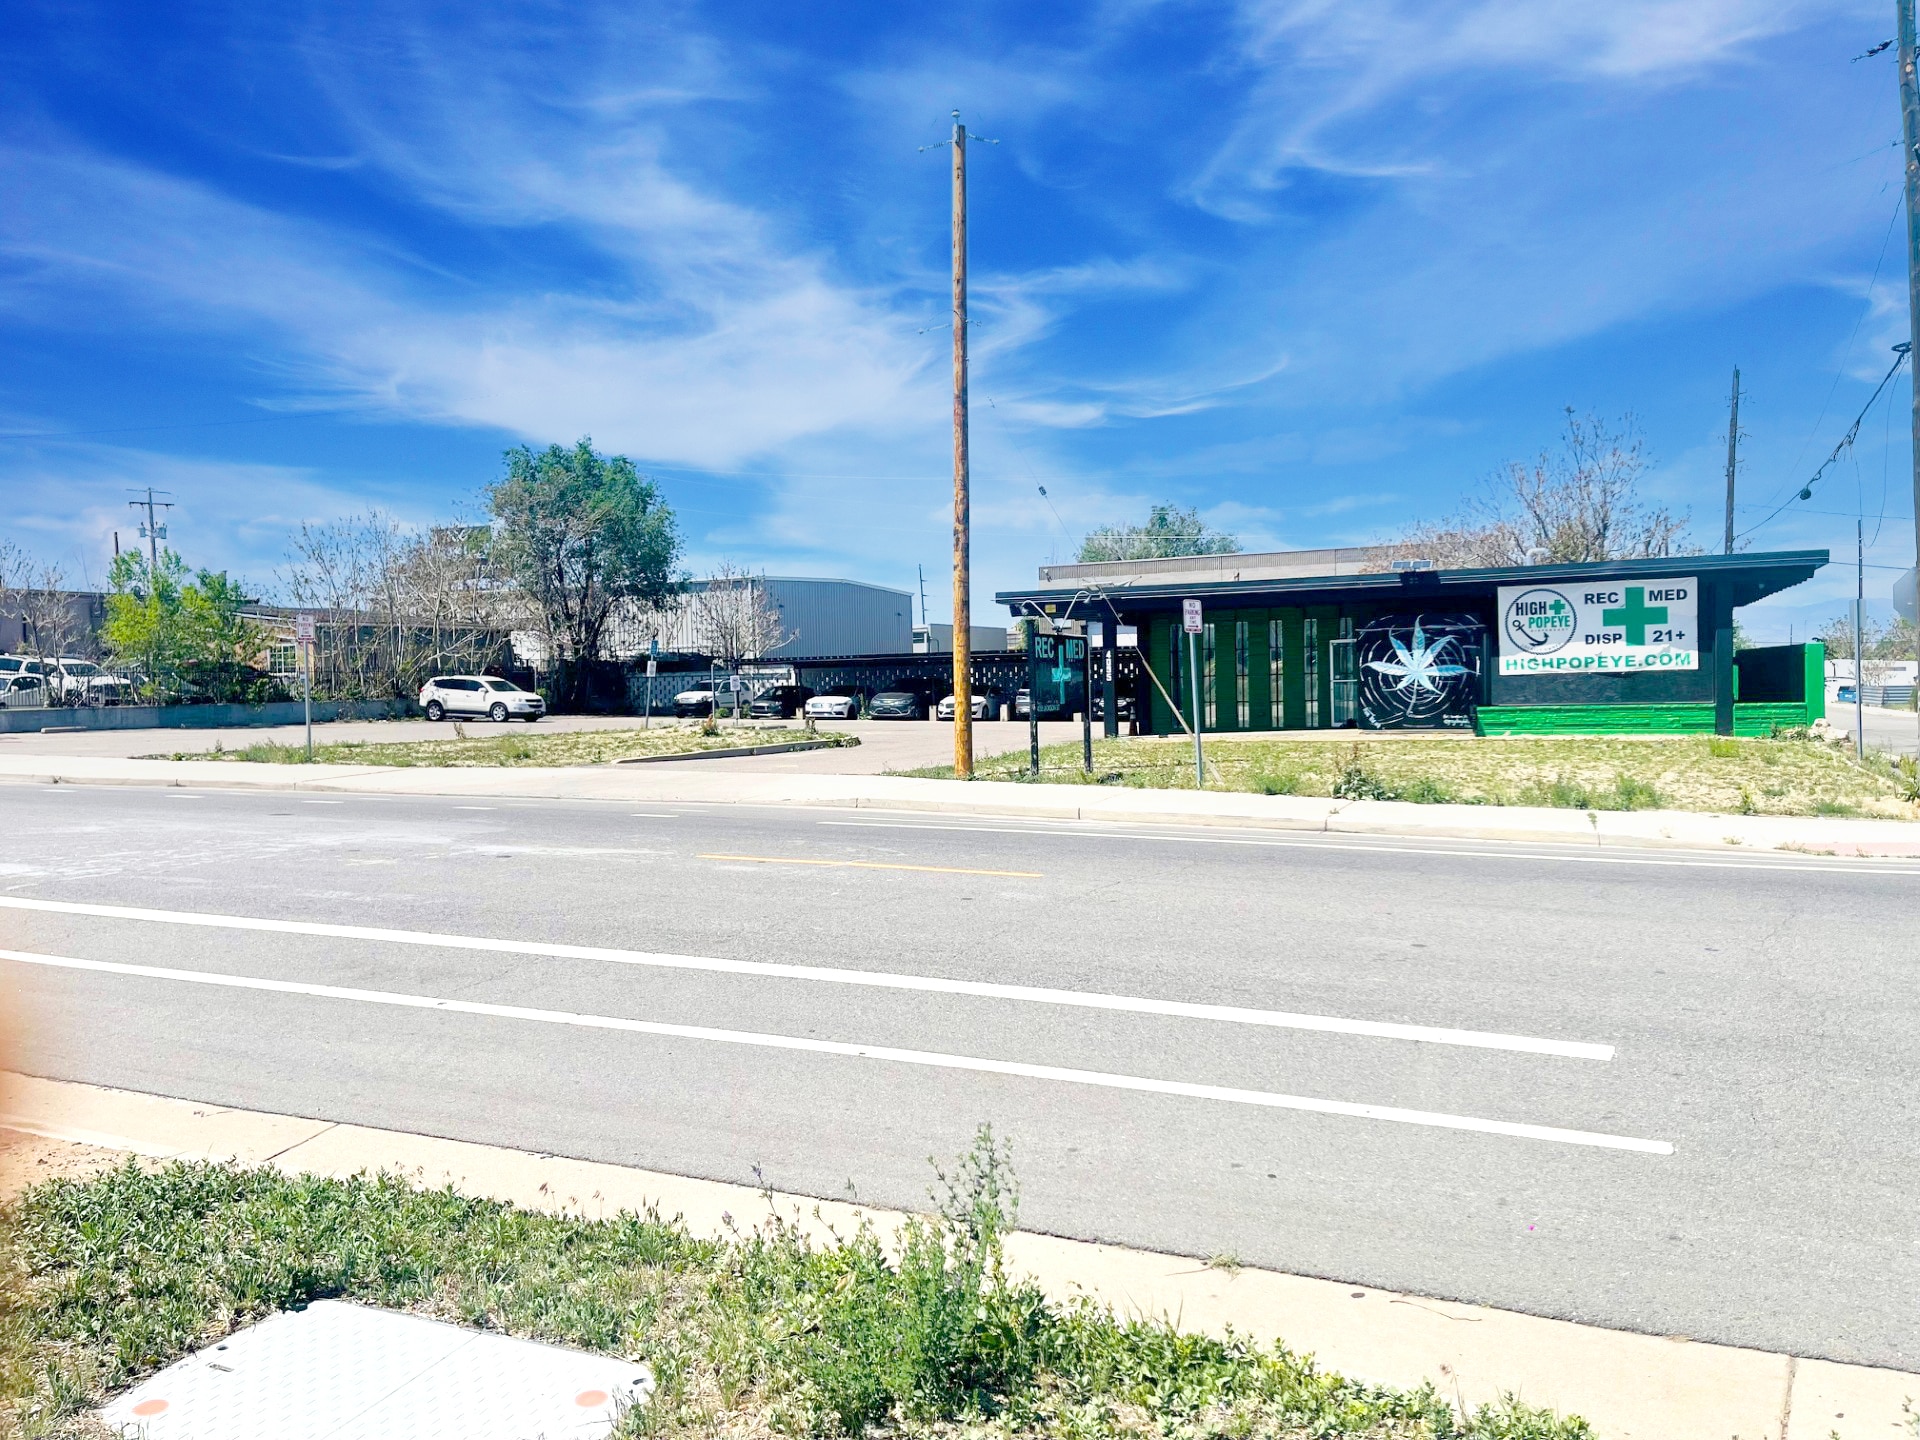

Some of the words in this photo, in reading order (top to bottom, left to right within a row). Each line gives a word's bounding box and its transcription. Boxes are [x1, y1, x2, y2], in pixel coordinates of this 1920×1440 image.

[1584, 592, 1619, 605] REC
[1649, 589, 1688, 602] MED
[1515, 601, 1547, 616] HIGH
[1528, 615, 1571, 629] POPEYE
[1585, 633, 1623, 645] DISP
[1652, 630, 1686, 643] 21+
[1034, 636, 1055, 659] REC
[1065, 639, 1085, 660] MED
[1505, 652, 1691, 672] HIGHPOPEYE.COM
